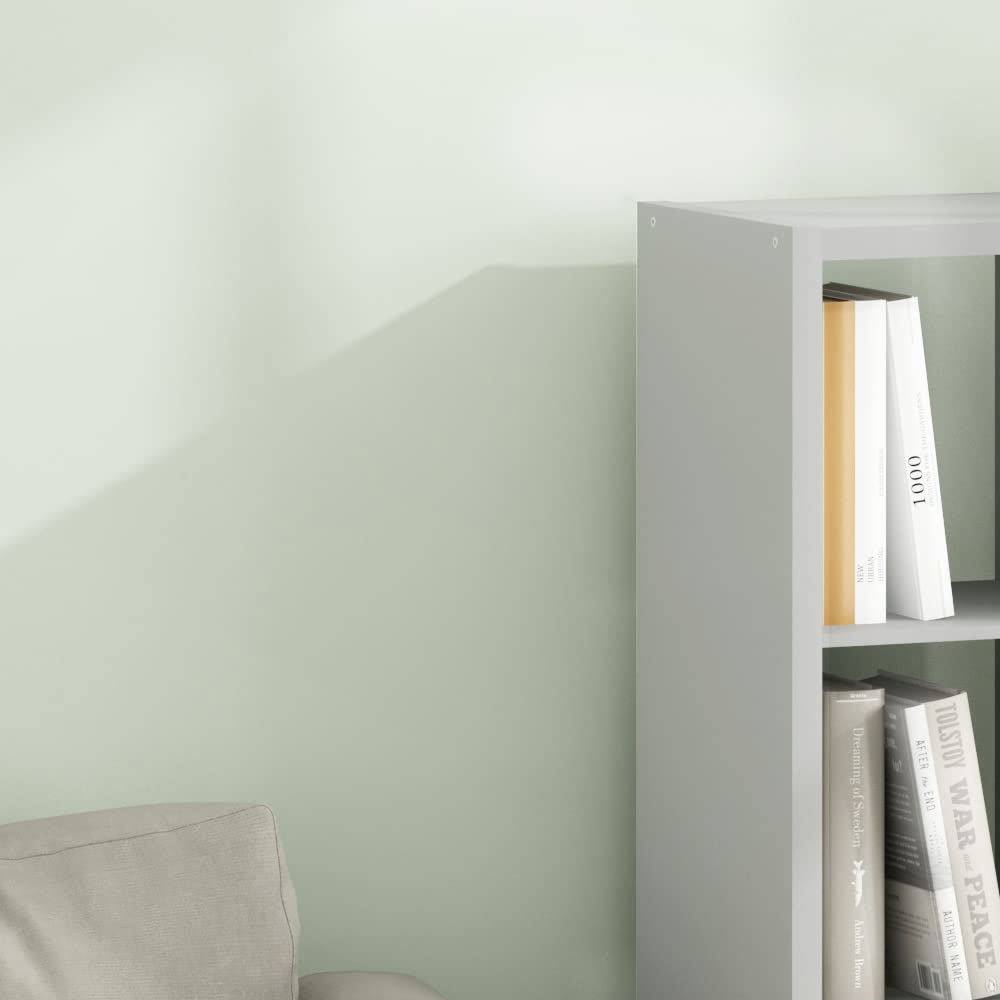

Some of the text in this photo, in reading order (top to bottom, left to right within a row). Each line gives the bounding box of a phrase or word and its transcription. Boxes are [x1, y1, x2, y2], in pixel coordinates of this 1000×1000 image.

[907, 455, 926, 505] 1000
[856, 564, 864, 583] NEW
[935, 702, 967, 768] TOLSTOY
[850, 727, 864, 848] Dreaming of Sweden
[914, 740, 929, 769] AFTER
[923, 791, 936, 811] END
[949, 777, 977, 850] WAR
[854, 919, 864, 989] Andrew Brown
[943, 911, 964, 984] AUTHOR NAME
[964, 873, 997, 969] PEACE
